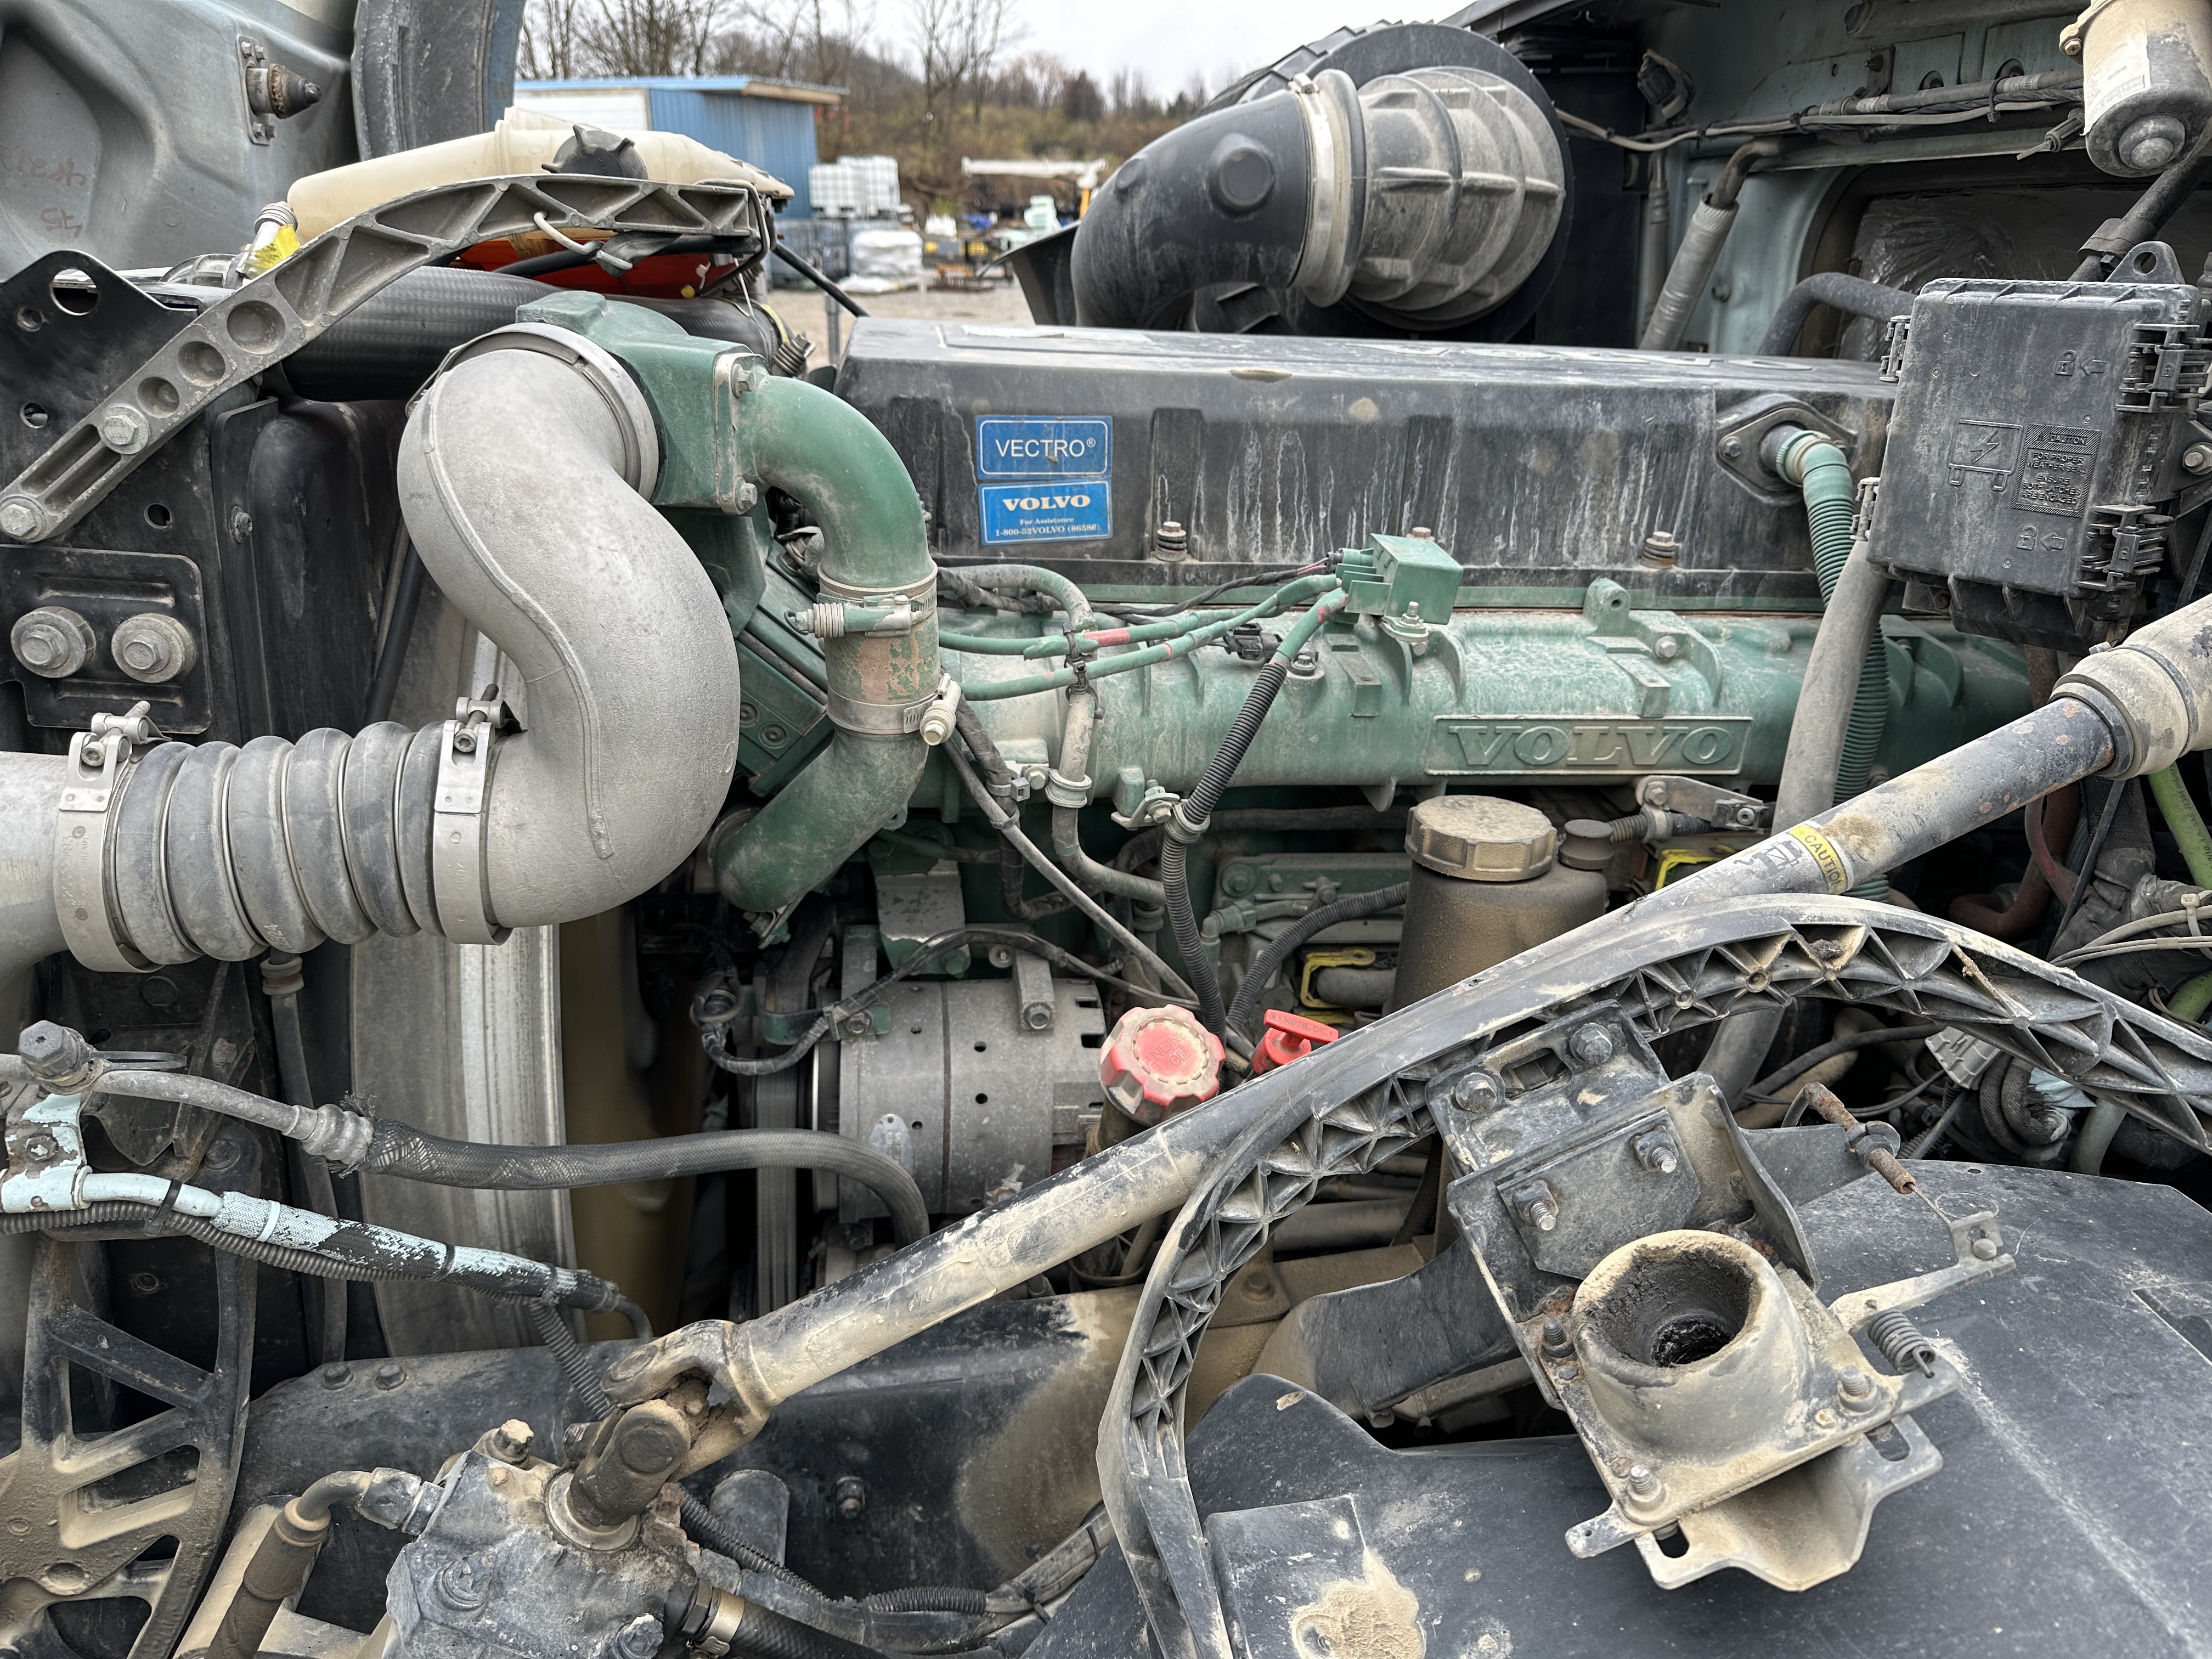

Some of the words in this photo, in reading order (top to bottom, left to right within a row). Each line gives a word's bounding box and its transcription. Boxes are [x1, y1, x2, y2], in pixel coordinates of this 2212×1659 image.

[2033, 451, 2050, 460] FOR
[2051, 454, 2085, 464] PROPER
[2027, 460, 2065, 471] WEATHER
[2023, 481, 2043, 489] BOTH
[2037, 474, 2070, 485] ENSURE
[1002, 495, 1091, 511] VOLVO
[2022, 491, 2038, 500] ARE
[2039, 493, 2078, 505] ENGAGED
[1035, 517, 1075, 525] Assistance
[995, 525, 1065, 537] 1-800-52VOLVO
[1068, 523, 1101, 532] (86586)
[1447, 725, 1734, 766] VOLVO
[1804, 834, 1844, 889] CAUTION
[1278, 1014, 1311, 1031] ENGINE
[1313, 1025, 1328, 1036] OIL
[1143, 1030, 1188, 1066] ENGINE
[1169, 1048, 1192, 1067] OIL
